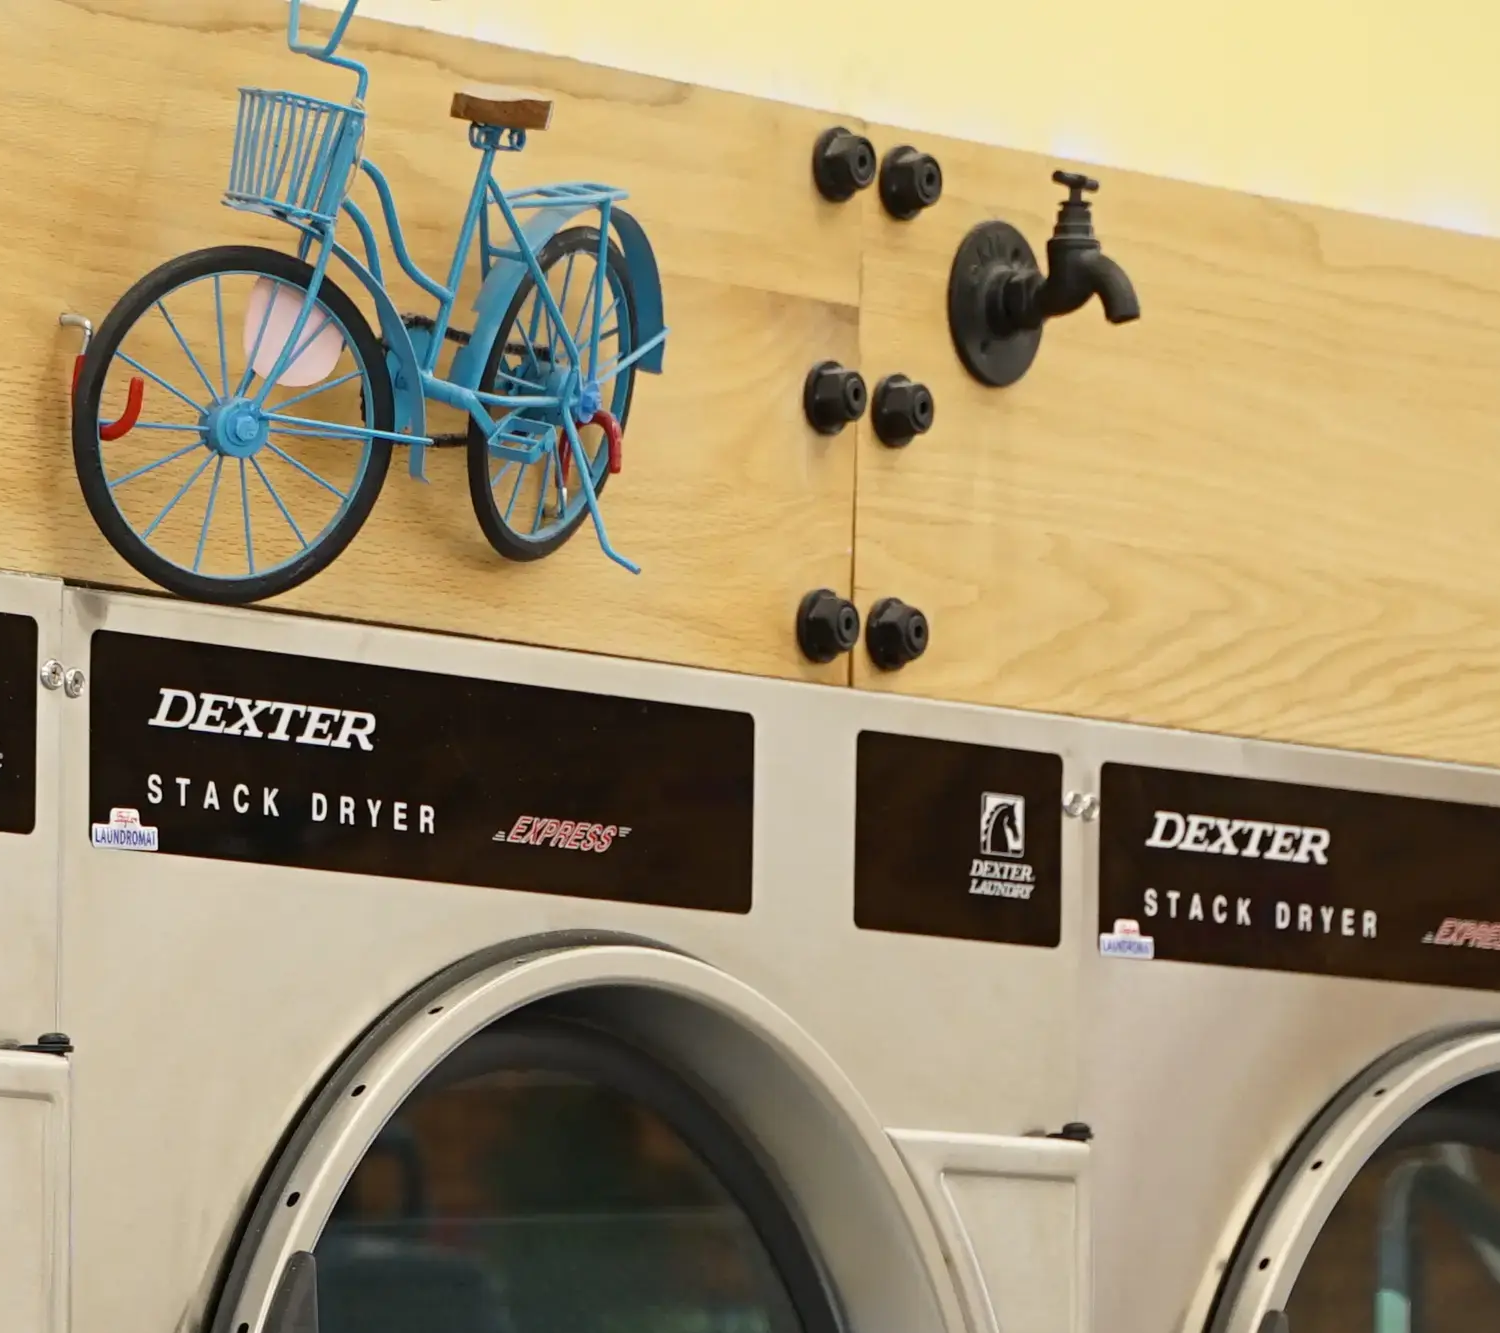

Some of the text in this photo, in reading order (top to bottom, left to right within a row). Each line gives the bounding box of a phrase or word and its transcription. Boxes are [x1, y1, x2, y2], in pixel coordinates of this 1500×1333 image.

[148, 687, 376, 751] DEXTER
[147, 773, 435, 834] STACK DRYER
[95, 827, 156, 846] LAUNDROMAT
[506, 815, 618, 853] EXPRESS
[1145, 810, 1331, 865] DEXTER
[968, 858, 1034, 882] DEXTER
[1144, 887, 1377, 938] STACK DRYER
